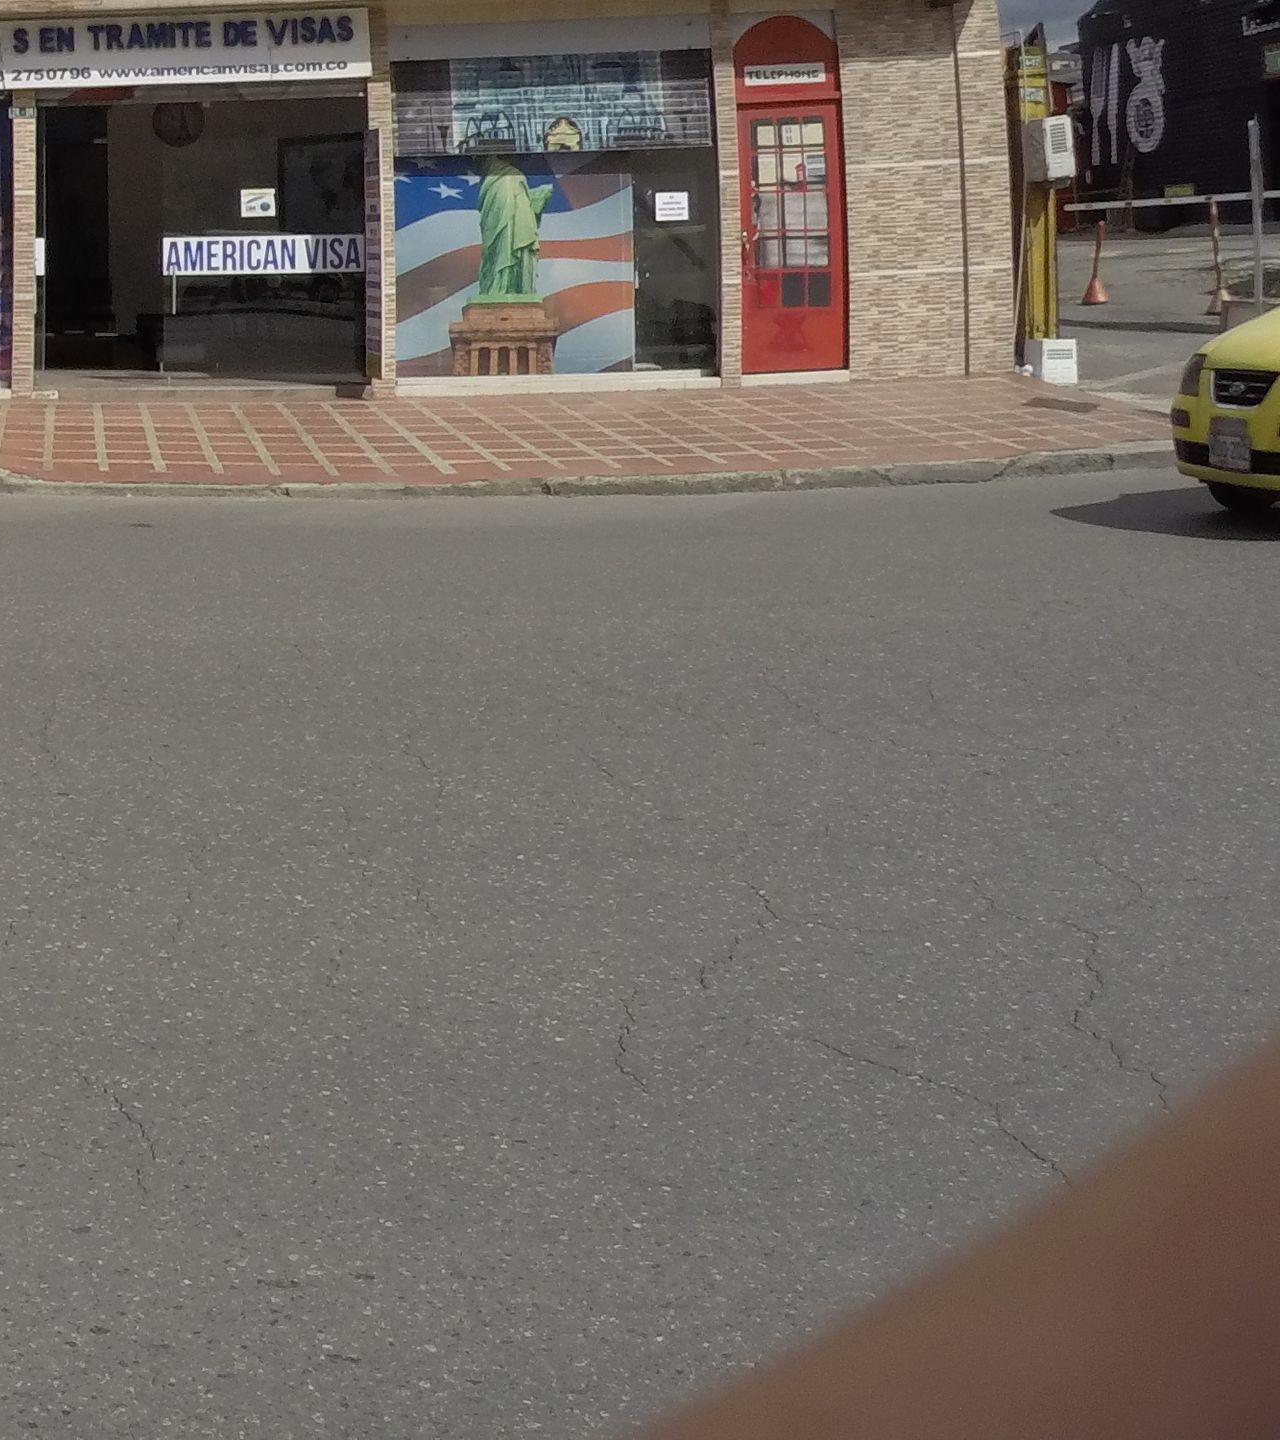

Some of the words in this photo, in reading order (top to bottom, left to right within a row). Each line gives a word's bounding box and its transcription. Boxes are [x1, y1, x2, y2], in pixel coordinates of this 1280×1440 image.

[39, 26, 75, 53] EN
[87, 21, 213, 51] TRAMITE
[223, 20, 258, 48] DE
[266, 15, 355, 47] VISAS
[746, 69, 820, 79] TELEPHONE
[166, 239, 297, 272] AMERICAN
[304, 237, 361, 270] VISA
